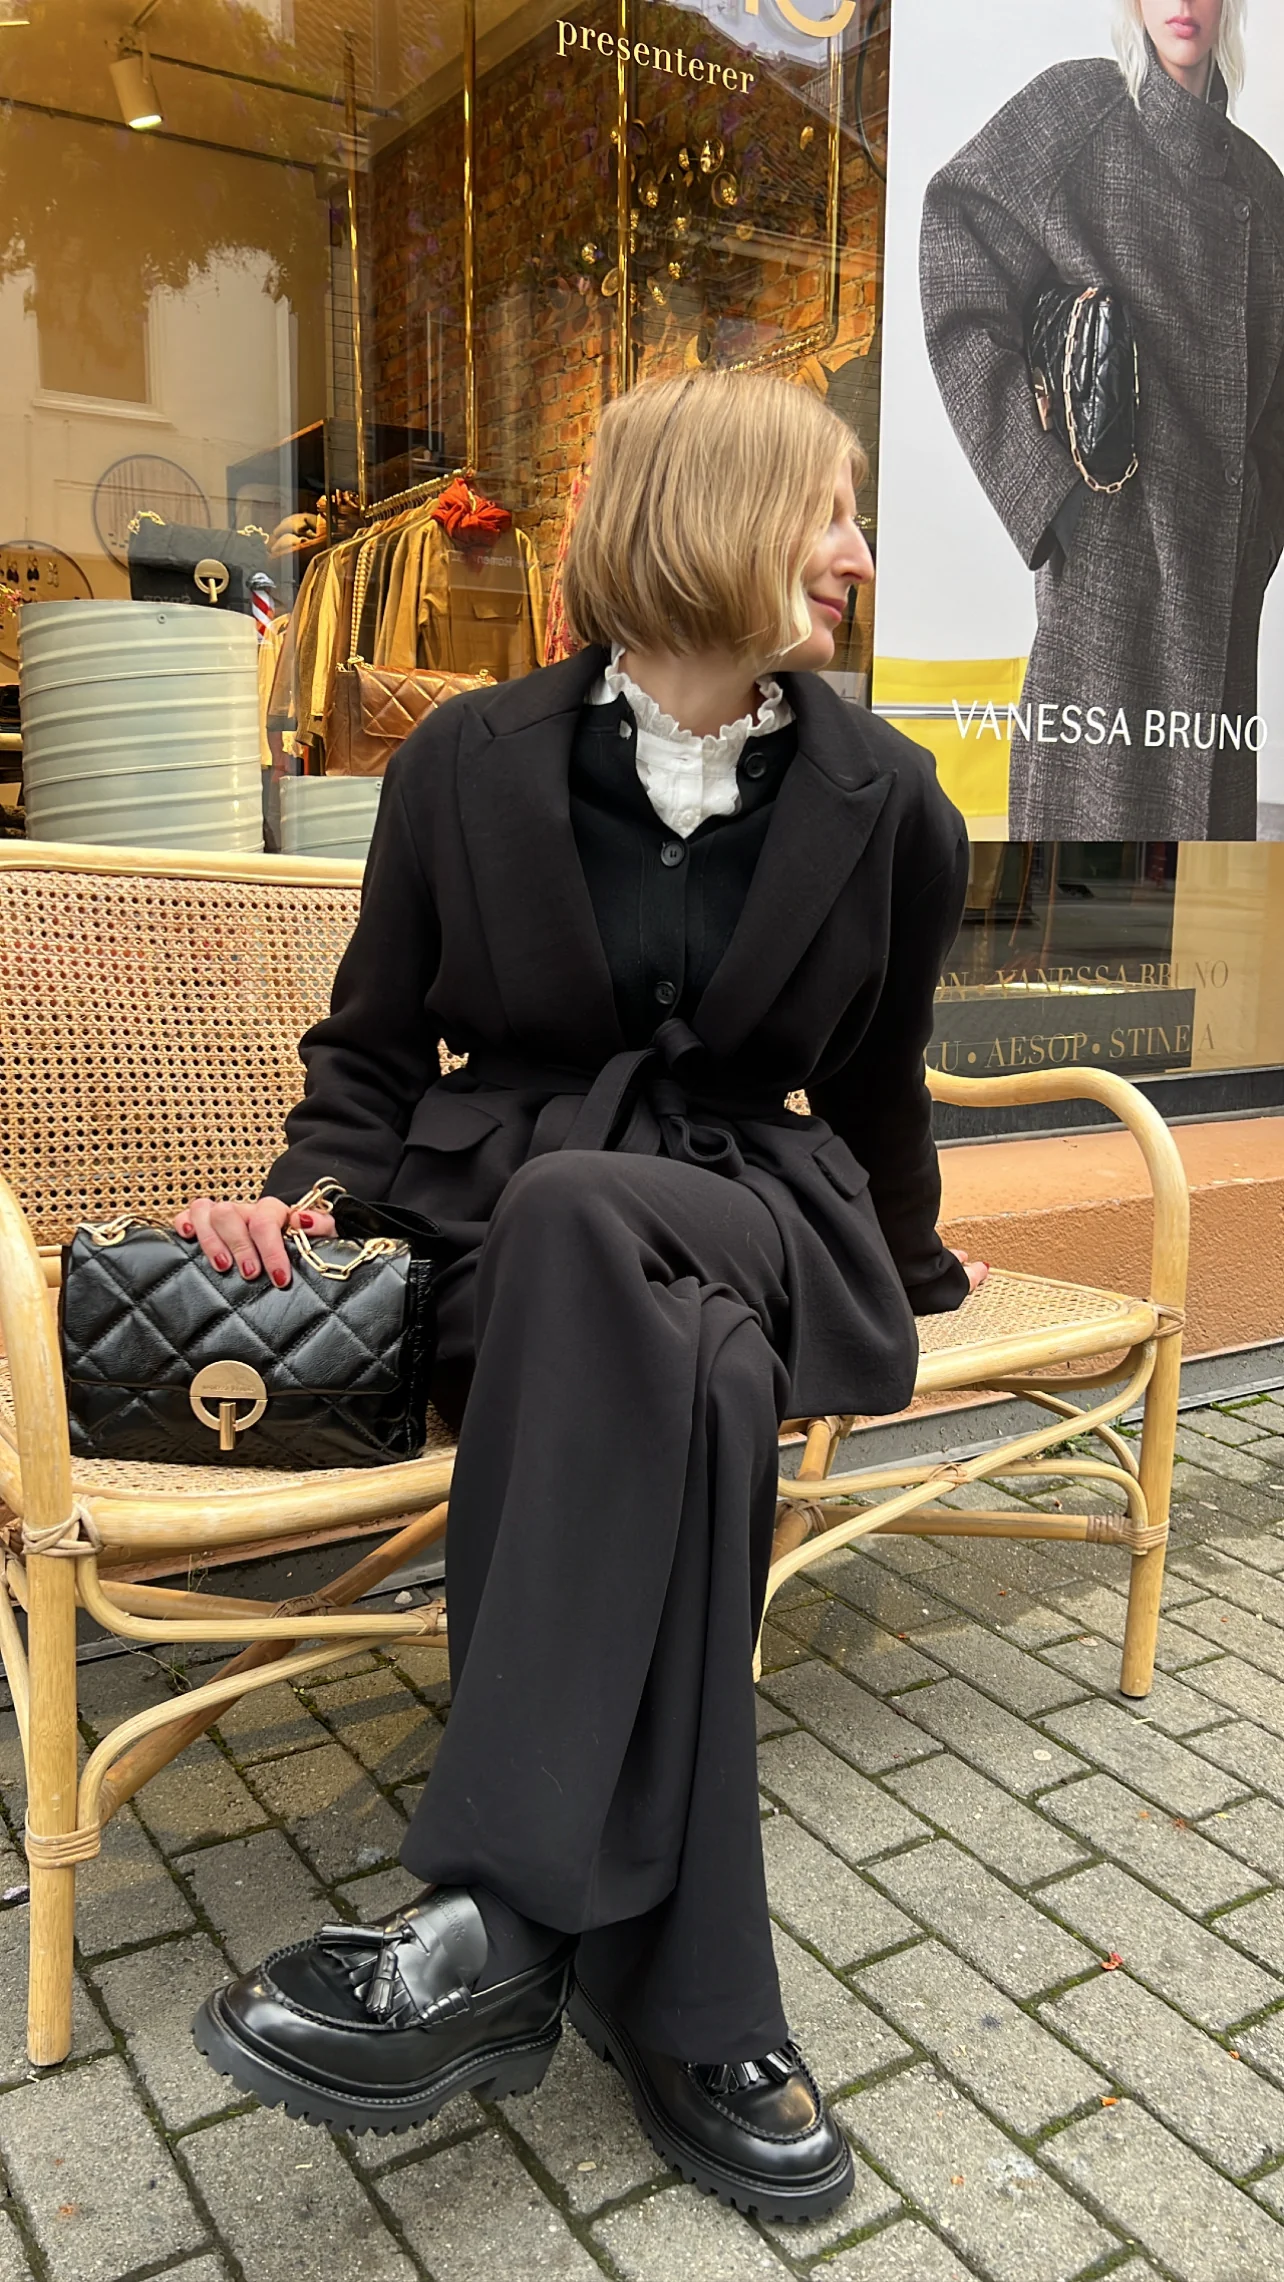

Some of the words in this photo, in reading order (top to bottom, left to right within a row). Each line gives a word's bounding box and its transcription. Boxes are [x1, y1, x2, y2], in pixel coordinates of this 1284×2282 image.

[556, 19, 755, 95] presenterer
[951, 698, 1132, 746] VANESSA
[1144, 709, 1268, 752] BRUNO
[995, 965, 1128, 998] VANESSA
[984, 1031, 1088, 1069] AESOP
[1108, 1024, 1191, 1059] STINE
[1198, 1022, 1216, 1051] A
